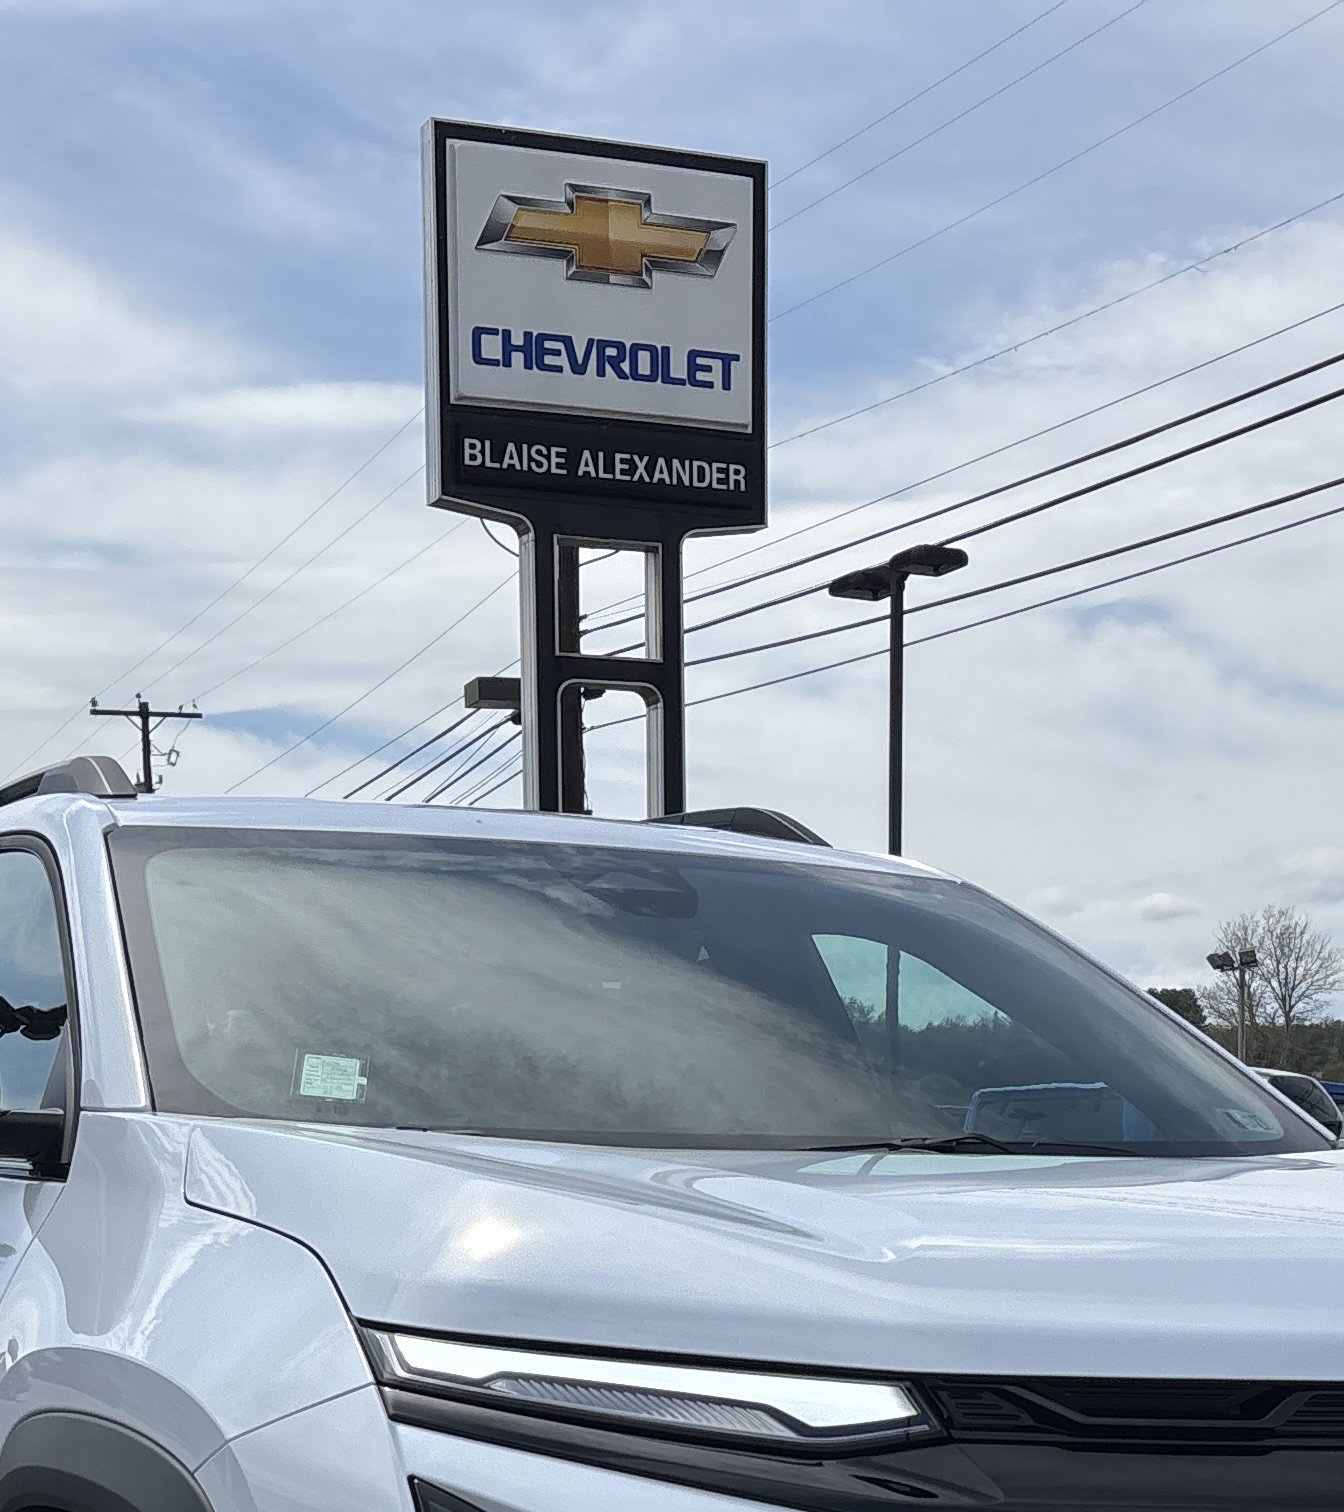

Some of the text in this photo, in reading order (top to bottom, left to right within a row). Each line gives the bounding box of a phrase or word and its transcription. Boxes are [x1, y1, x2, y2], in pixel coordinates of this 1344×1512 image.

[471, 326, 741, 391] CHEVROLET
[462, 436, 748, 493] BLAISE ALEXANDER
